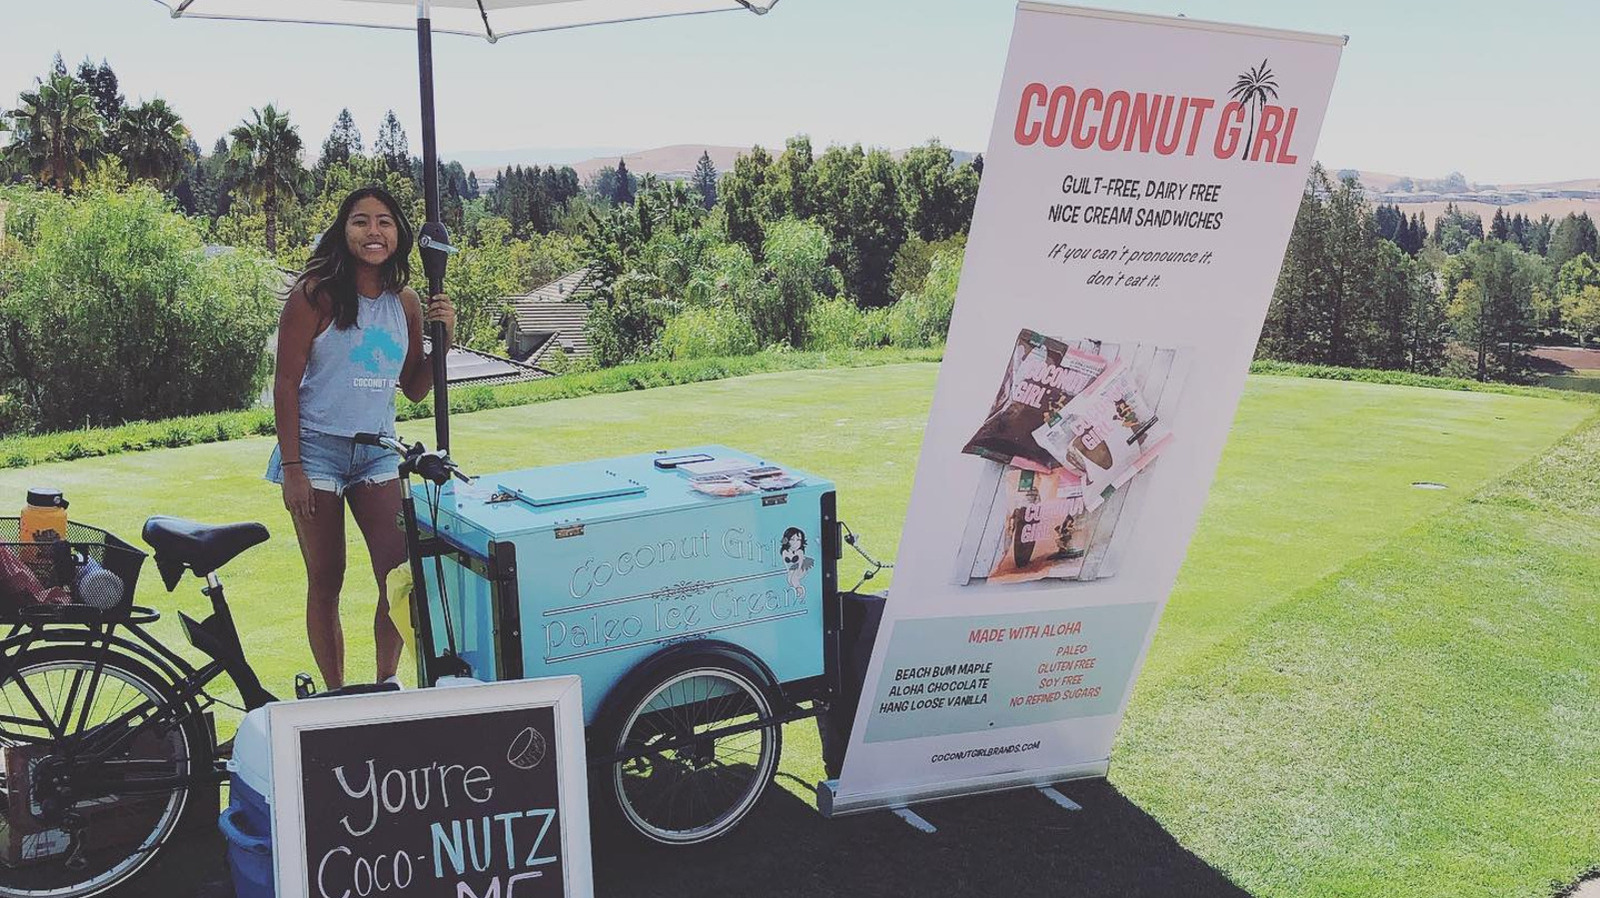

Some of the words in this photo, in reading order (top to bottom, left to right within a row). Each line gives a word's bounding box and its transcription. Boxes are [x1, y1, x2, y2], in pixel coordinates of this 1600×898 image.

[1014, 82, 1215, 156] COCONUT
[1213, 100, 1299, 165] GIRL
[1062, 175, 1140, 201] GUILT-FREE,
[1145, 180, 1188, 200] DAIRY
[1189, 184, 1222, 202] FREE
[1048, 204, 1081, 223] NICE
[1084, 206, 1133, 225] CREAM
[1135, 208, 1223, 230] SANDWICHES
[1048, 243, 1067, 258] If
[1063, 248, 1091, 264] you
[1092, 245, 1129, 261] can't
[1124, 249, 1198, 265] pronounce
[1086, 270, 1125, 286] don't
[1124, 275, 1148, 287] eat
[353, 378, 387, 388] COCONUT
[568, 531, 711, 599] Coconut
[721, 528, 778, 567] Girl
[542, 613, 643, 661] Paleo
[654, 600, 701, 631] Ice
[709, 584, 807, 620] Cream
[969, 629, 1006, 643] MADE
[1009, 625, 1040, 640] WITH
[1041, 621, 1082, 638] ALOHA
[1056, 645, 1087, 656] PALEO
[895, 666, 932, 681] BEACH
[932, 664, 957, 678] BUM
[957, 662, 993, 675] MAPLE
[1038, 660, 1075, 674] GLUTEN
[1074, 658, 1096, 670] FREE
[888, 683, 924, 697] ALOHA
[927, 678, 990, 693] CHOCOLATE
[1039, 677, 1061, 689] SOY
[1061, 674, 1084, 686] FREE
[879, 700, 909, 714] HANG
[910, 697, 945, 711] LOOSE
[947, 693, 988, 706] VANILLA
[1010, 696, 1024, 707] NO
[1025, 691, 1061, 706] REFINED
[1062, 686, 1101, 700] SUGARS
[931, 741, 1041, 763] COCONUTGIRLBRANDS.COM
